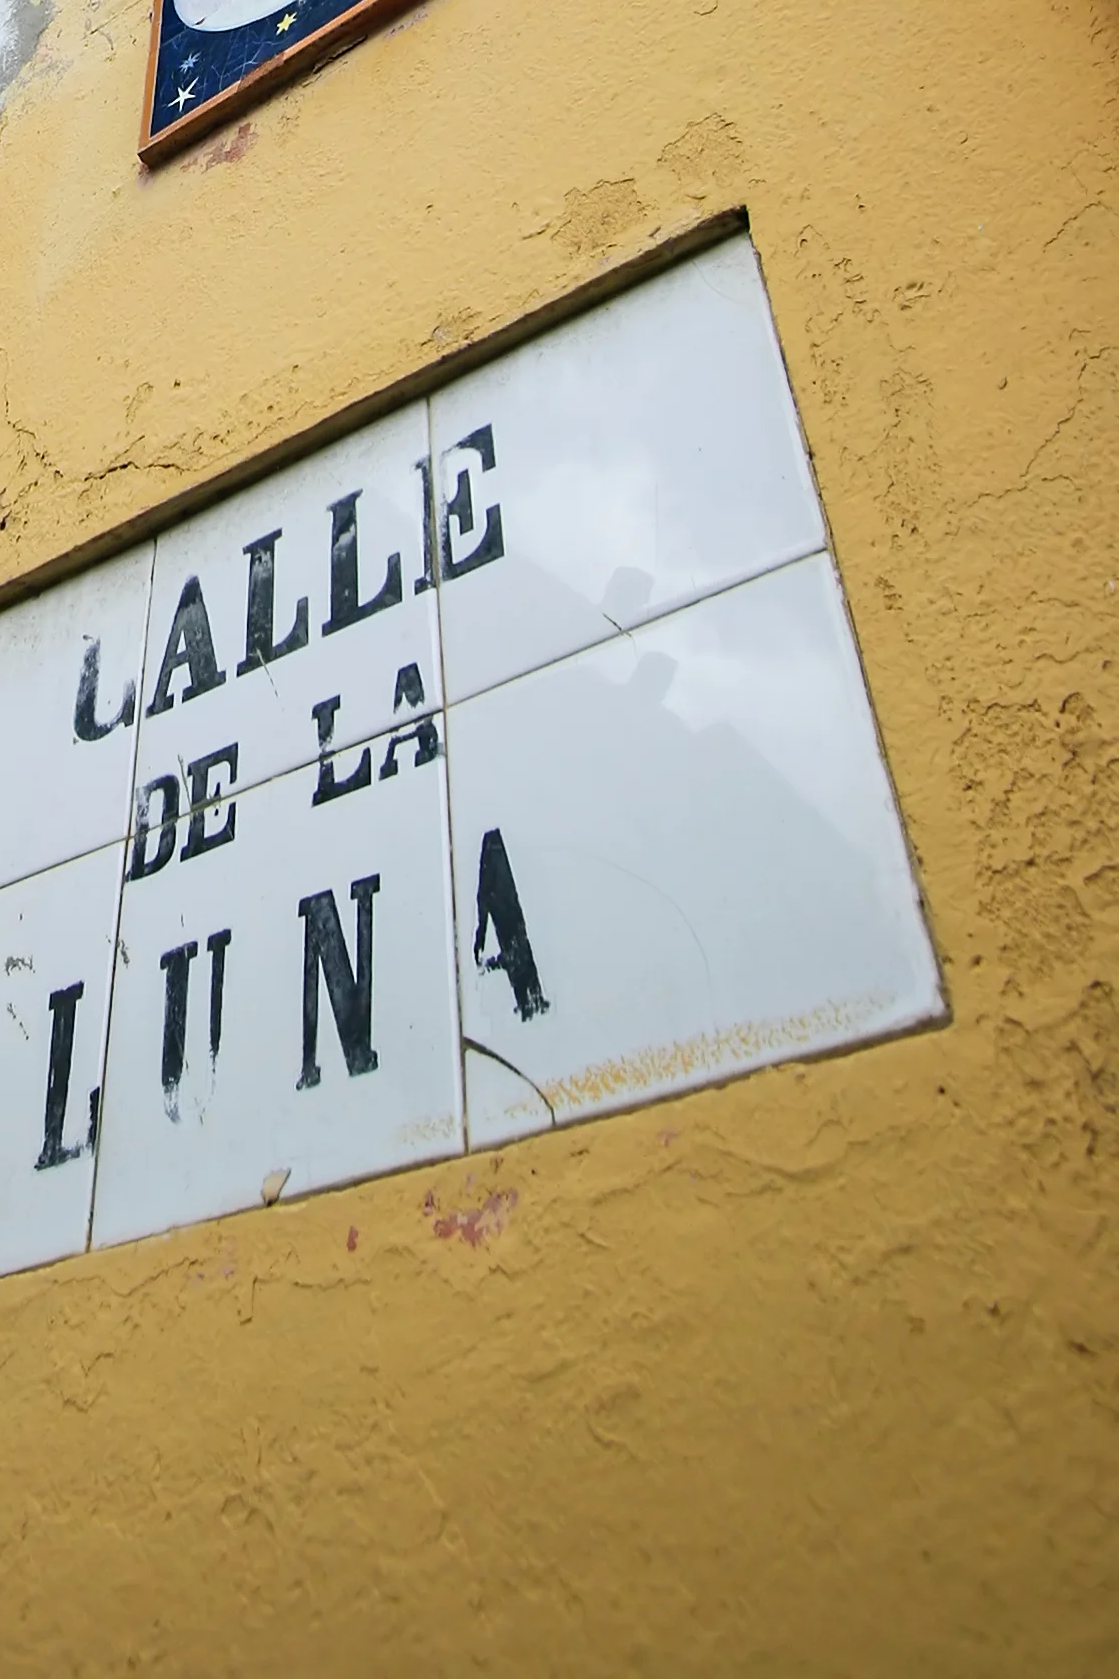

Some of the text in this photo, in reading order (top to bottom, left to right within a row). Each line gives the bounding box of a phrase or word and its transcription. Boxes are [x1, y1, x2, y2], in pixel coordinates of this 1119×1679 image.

[72, 422, 505, 745] CALLE
[125, 662, 443, 884] DE LA
[34, 827, 551, 1172] LUNA
